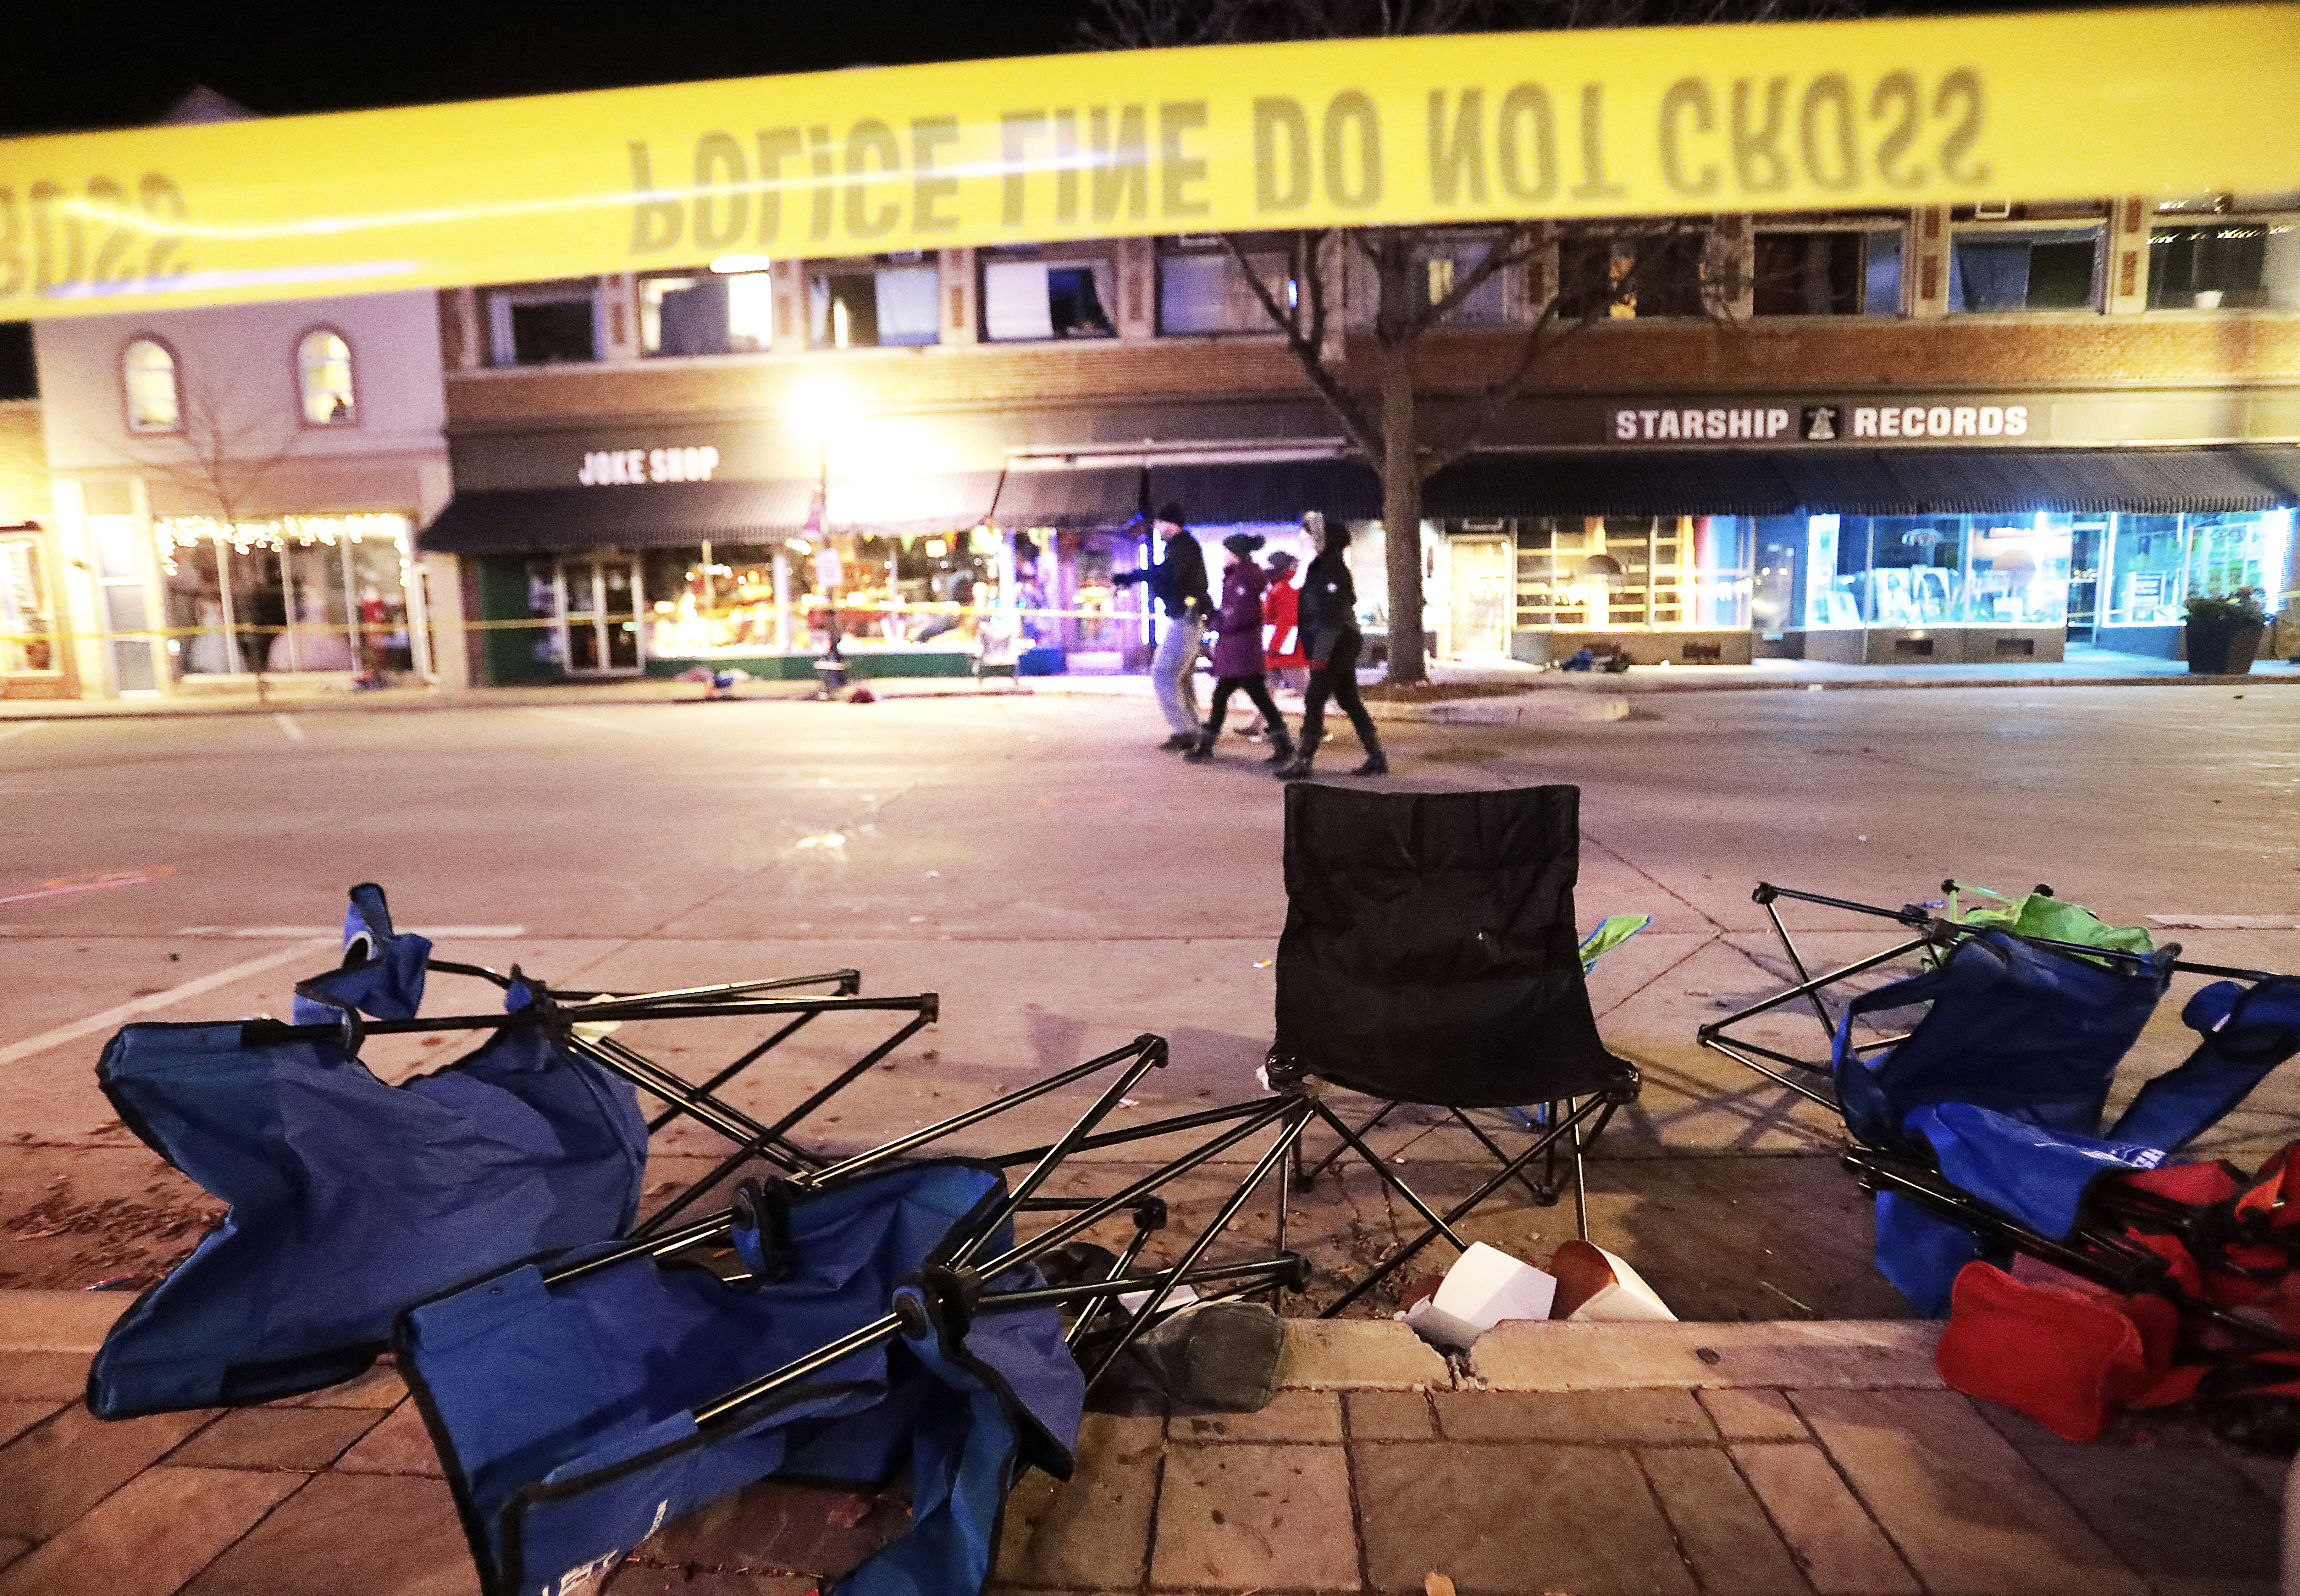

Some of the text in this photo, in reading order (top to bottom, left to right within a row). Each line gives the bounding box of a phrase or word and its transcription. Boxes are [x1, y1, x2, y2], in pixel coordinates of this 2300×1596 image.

[1616, 407, 2028, 439] STARSHIP RECORDS
[579, 447, 719, 485] JOKE SHOP
